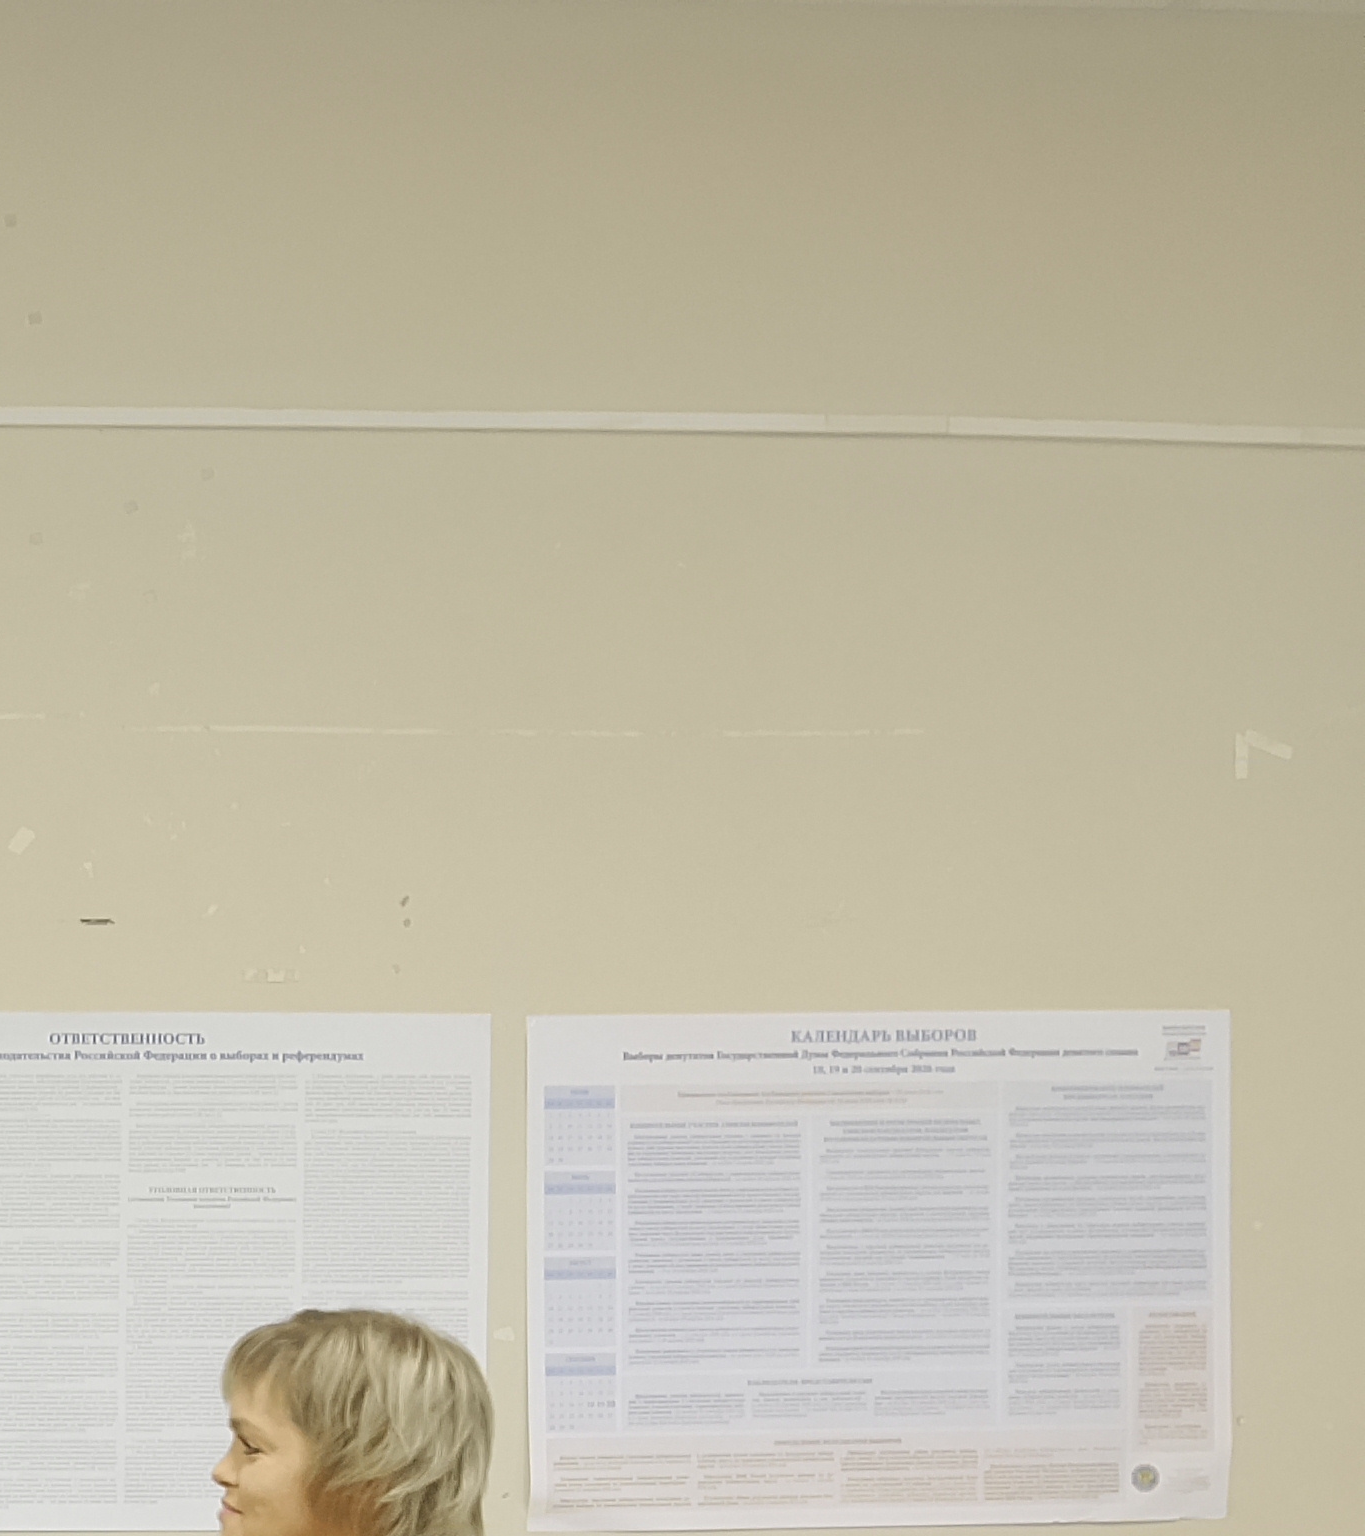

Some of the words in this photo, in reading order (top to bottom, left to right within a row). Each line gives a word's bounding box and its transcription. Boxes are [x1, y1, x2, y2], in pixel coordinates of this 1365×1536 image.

[49, 1033, 205, 1045] ОТВЕТСТВЕННОСТЬ
[791, 1029, 891, 1043] КАЛЕНДАРЬ
[896, 1029, 977, 1042] ВЫБОРОВ
[74, 1050, 140, 1060] Российской
[143, 1051, 207, 1062] Федерации
[219, 1051, 269, 1062] выборах
[282, 1051, 364, 1063] референдумах
